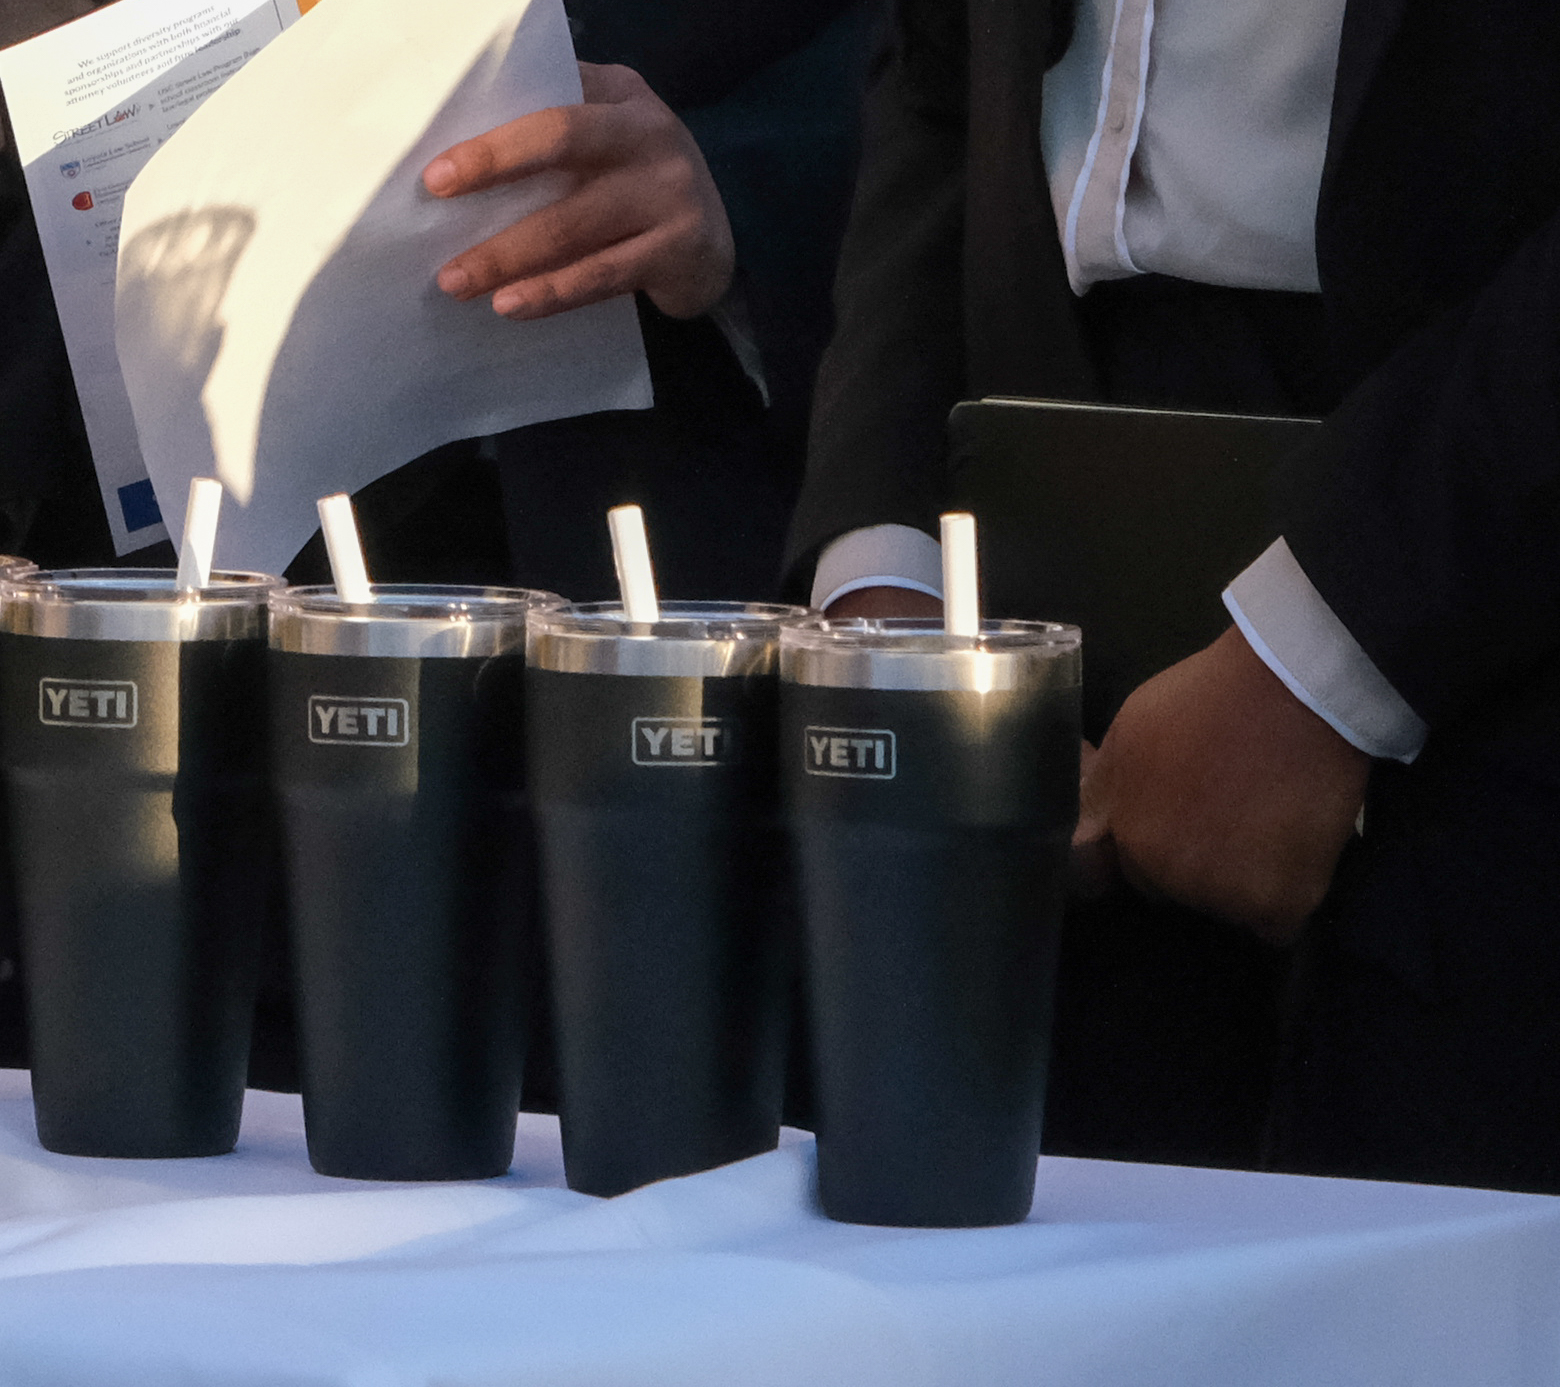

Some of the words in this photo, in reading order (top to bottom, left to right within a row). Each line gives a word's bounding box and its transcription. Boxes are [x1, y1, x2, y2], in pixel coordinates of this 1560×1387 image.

[67, 72, 84, 85] and
[149, 38, 169, 51] with
[171, 27, 192, 42] both
[77, 57, 95, 69] We
[96, 43, 132, 63] support
[133, 25, 171, 46] diversity
[173, 5, 215, 30] programs
[125, 59, 143, 72] and
[144, 35, 200, 66] partnerships
[201, 24, 222, 38] with
[66, 86, 105, 107] attorney
[106, 67, 154, 91] volunteers
[46, 687, 128, 721] YETI
[314, 704, 400, 738] YETI
[810, 737, 886, 770] YETI
